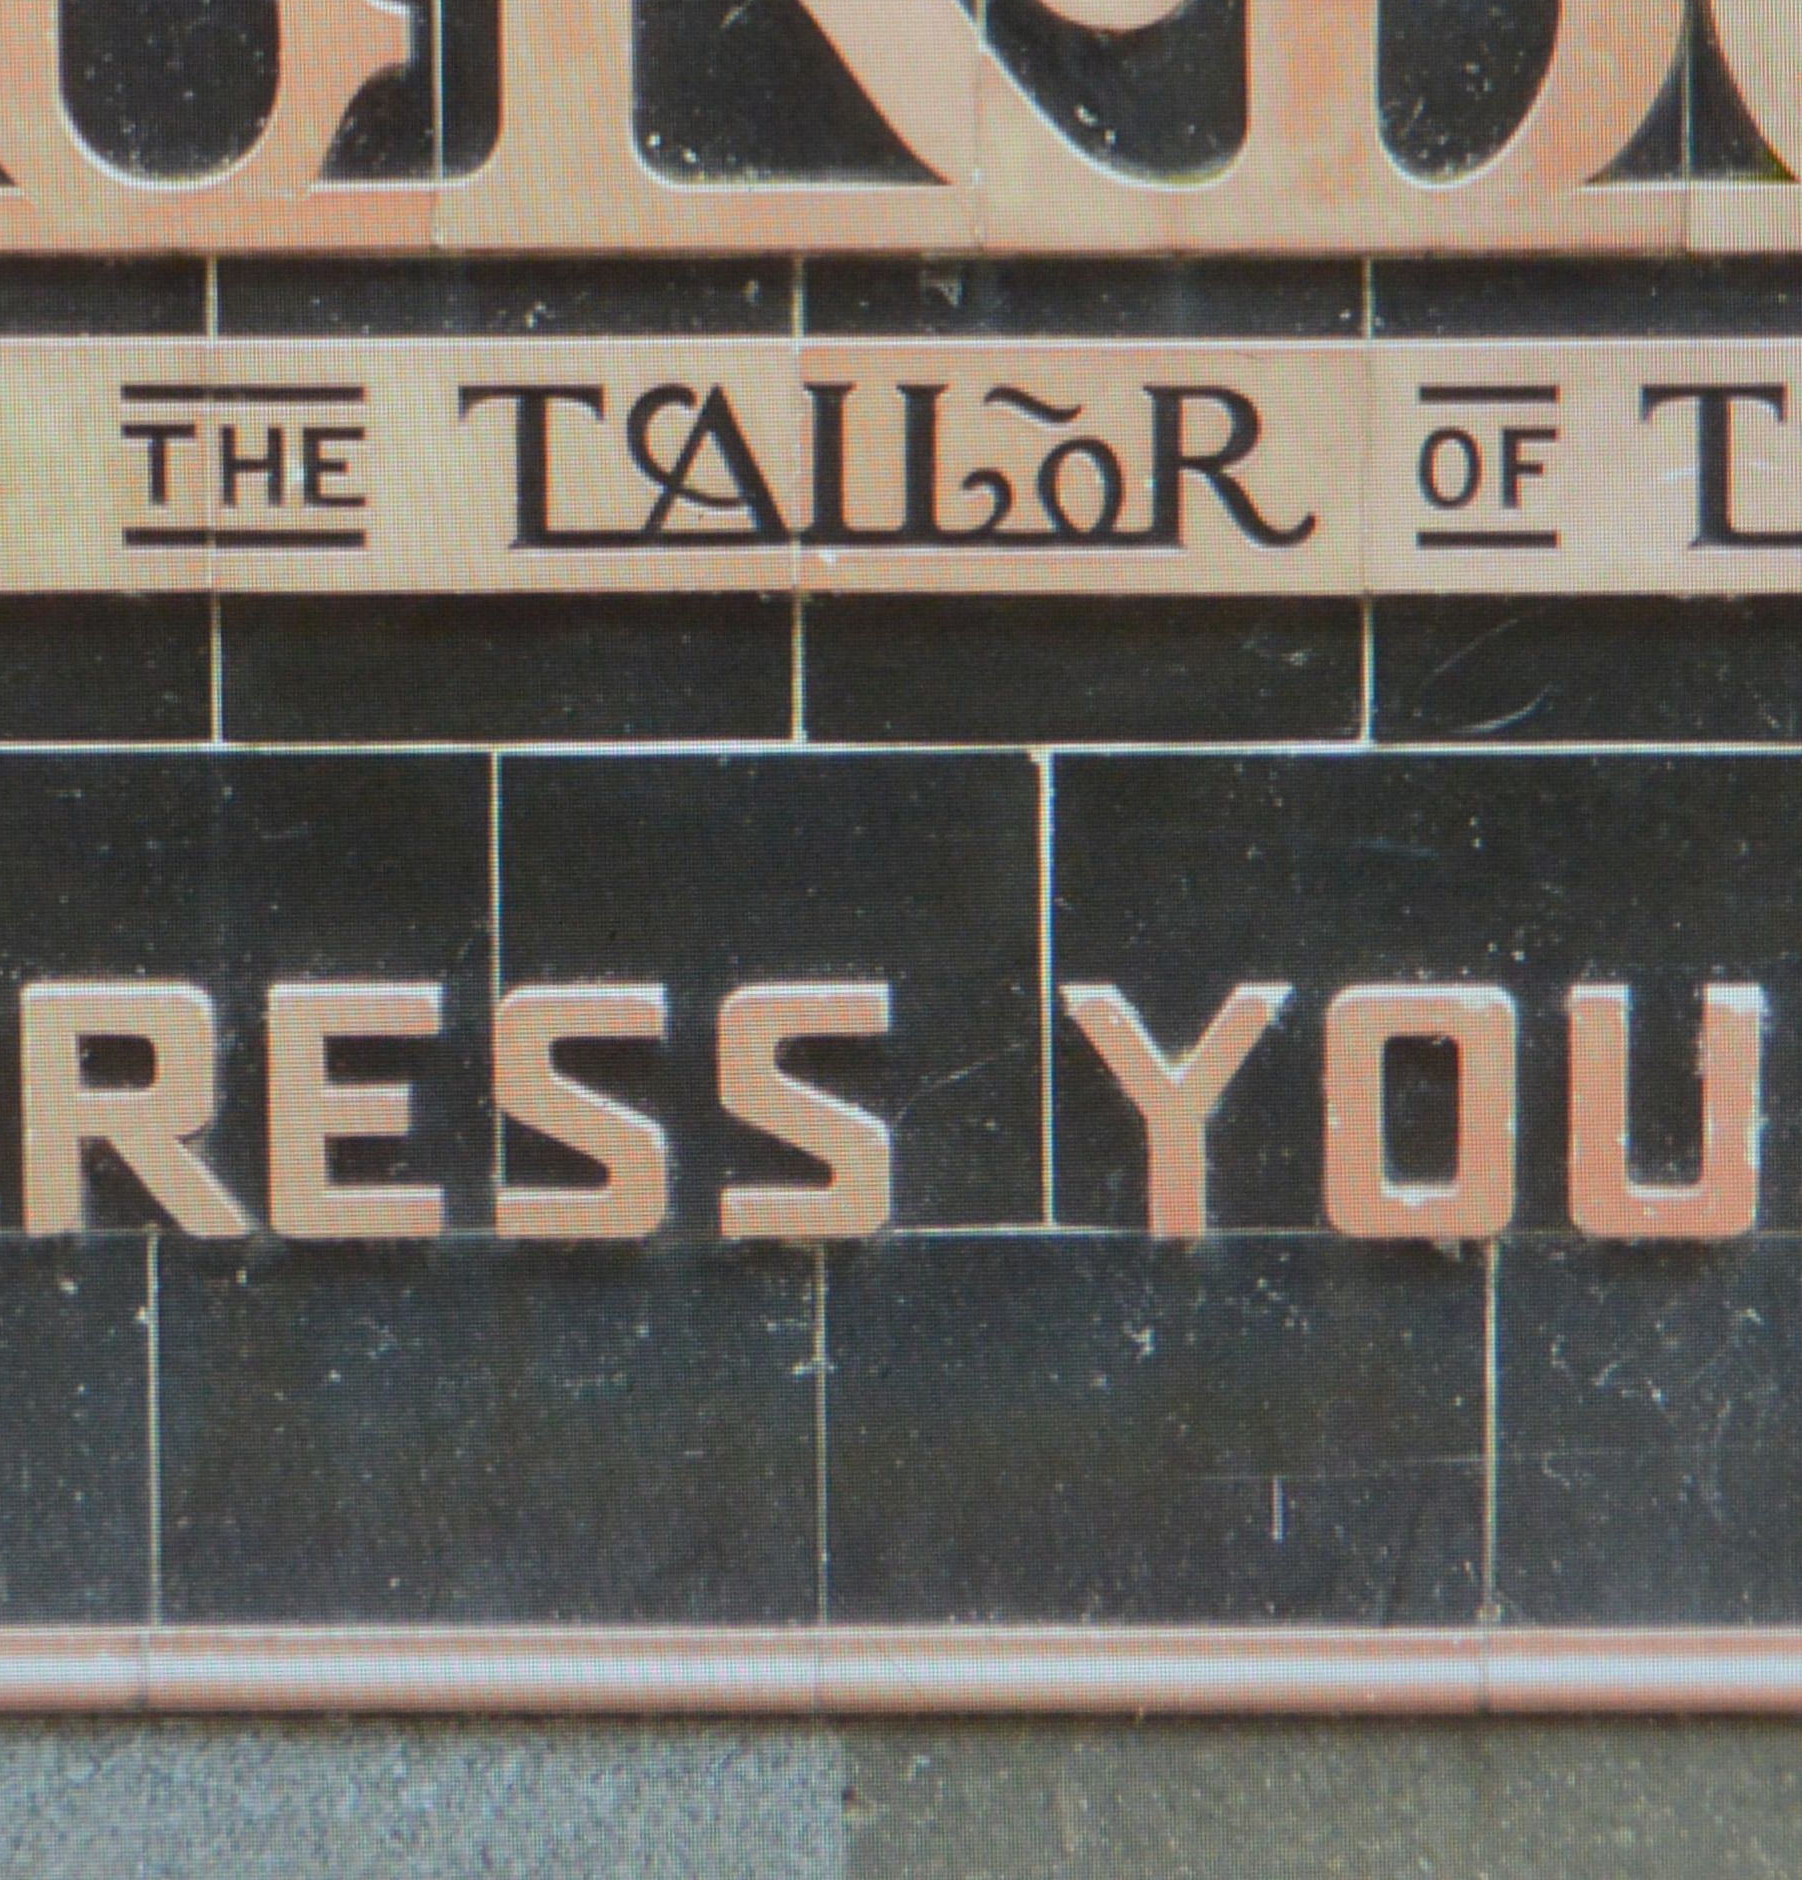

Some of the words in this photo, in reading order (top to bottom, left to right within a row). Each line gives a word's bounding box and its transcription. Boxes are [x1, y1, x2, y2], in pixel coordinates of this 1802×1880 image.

[122, 423, 367, 510] THE
[457, 381, 1318, 551] TAILOR
[1415, 425, 1558, 512] OF
